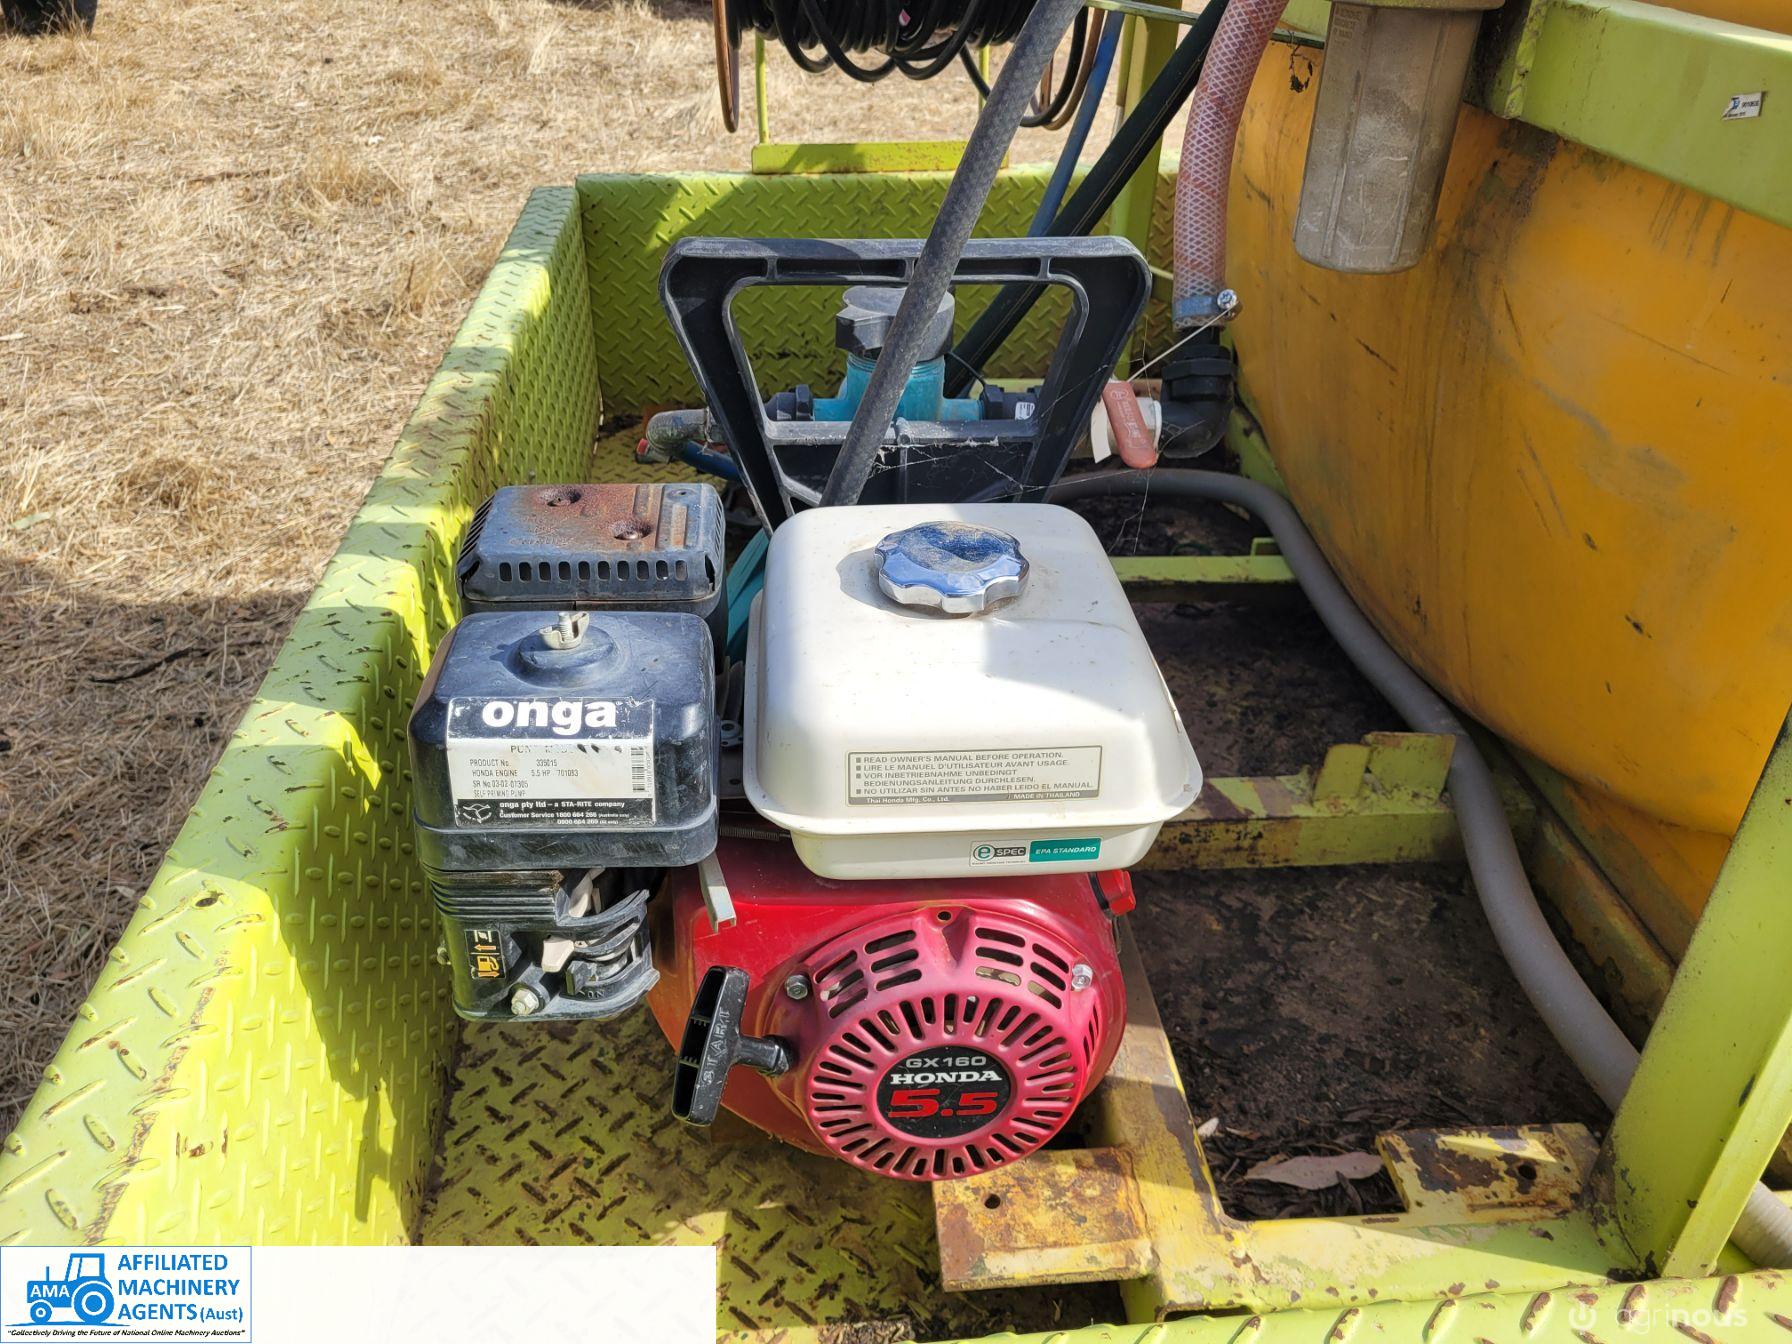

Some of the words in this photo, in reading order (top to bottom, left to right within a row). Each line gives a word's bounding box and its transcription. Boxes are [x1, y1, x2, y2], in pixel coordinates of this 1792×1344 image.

[482, 700, 617, 736] onga
[469, 759, 498, 767] PRODUCT
[863, 756, 888, 764] READ
[890, 755, 932, 763] OWNER'S
[933, 754, 973, 762] MANUAL
[975, 753, 1009, 761] BEFORE
[1011, 752, 1064, 760] OPERATION.
[897, 763, 936, 771] MANUEL
[938, 760, 1003, 770] D'UTILISATEUR
[1004, 760, 1034, 768] AVANT
[472, 769, 494, 777] HONDA
[495, 769, 518, 777] ENGINE
[542, 769, 551, 777] HP
[884, 770, 963, 779] INBETRIEBNAHME
[965, 769, 1018, 778] UNBEDINGT
[863, 778, 973, 787] BEDIENUNGSANLEITUNG
[975, 776, 1036, 784] DURCHLESEN.
[879, 787, 918, 795] UTILIZAR
[983, 784, 1013, 792] HABER
[1045, 791, 1080, 799] THAILAND
[499, 801, 520, 810] onga
[521, 801, 534, 810] pty
[996, 847, 1025, 856] SPEC
[1052, 846, 1097, 854] STANDARD
[702, 1006, 730, 1086] START
[890, 1070, 1003, 1085] HONDA
[888, 1088, 999, 1118] 5.5
